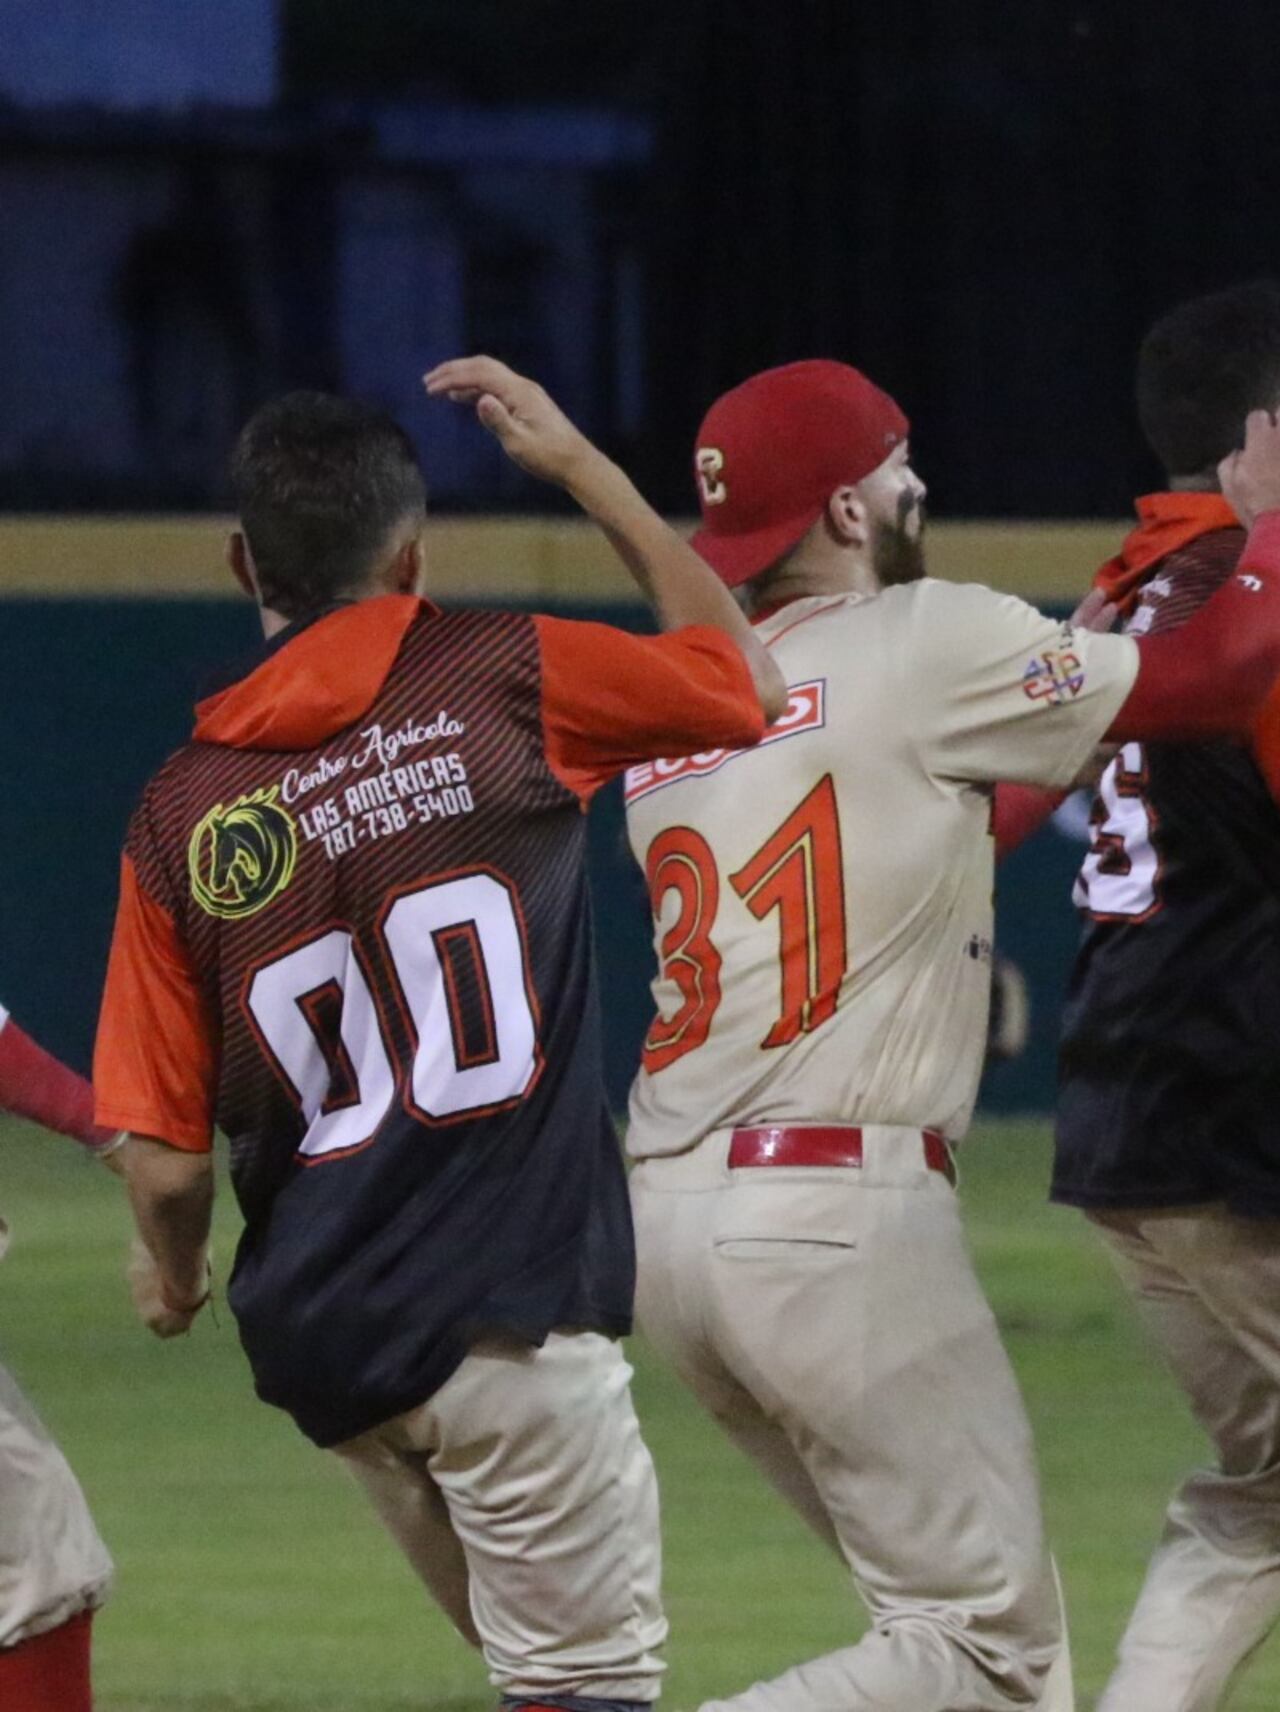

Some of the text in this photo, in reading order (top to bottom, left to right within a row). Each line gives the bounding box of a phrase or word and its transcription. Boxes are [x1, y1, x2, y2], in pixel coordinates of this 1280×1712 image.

[281, 757, 348, 803] Centro
[299, 798, 342, 841] LAS
[321, 785, 475, 860] 787-738-5400
[640, 772, 848, 1076] 31
[243, 867, 543, 1163] 00
